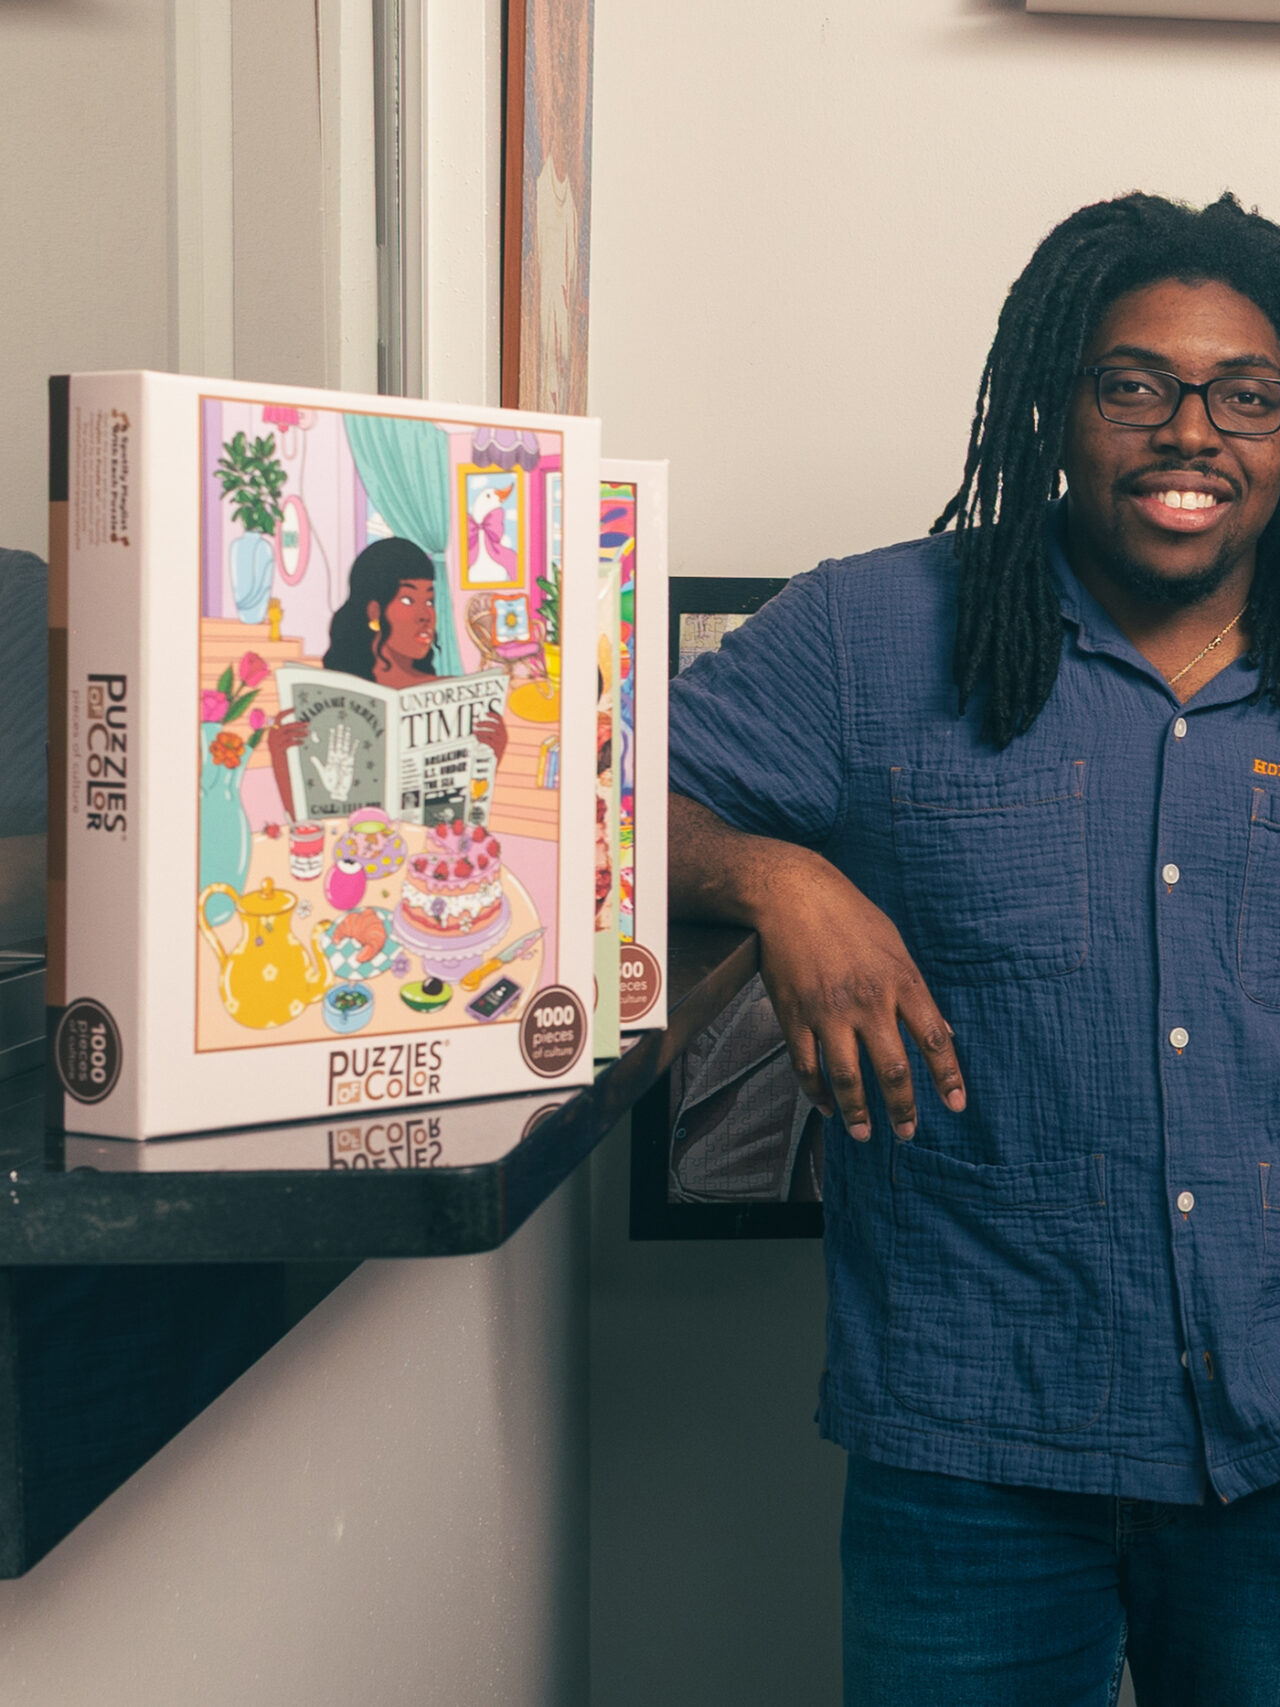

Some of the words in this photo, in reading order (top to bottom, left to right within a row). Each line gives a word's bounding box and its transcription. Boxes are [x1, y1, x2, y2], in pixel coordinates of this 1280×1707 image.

[119, 437, 128, 482] Spotify
[110, 491, 119, 531] Puzzle
[119, 485, 128, 531] Playlist
[71, 690, 80, 738] pieces
[400, 680, 504, 712] UNFORESEEN
[72, 743, 81, 758] of
[87, 674, 127, 832] PUZZLES
[72, 763, 80, 814] culture
[619, 961, 644, 979] 00
[619, 980, 648, 992] eces
[532, 1030, 575, 1048] pieces
[533, 1005, 575, 1028] 1000
[78, 1020, 89, 1081] pieces
[91, 1023, 106, 1084] 1000
[327, 1040, 443, 1107] PUZZLES
